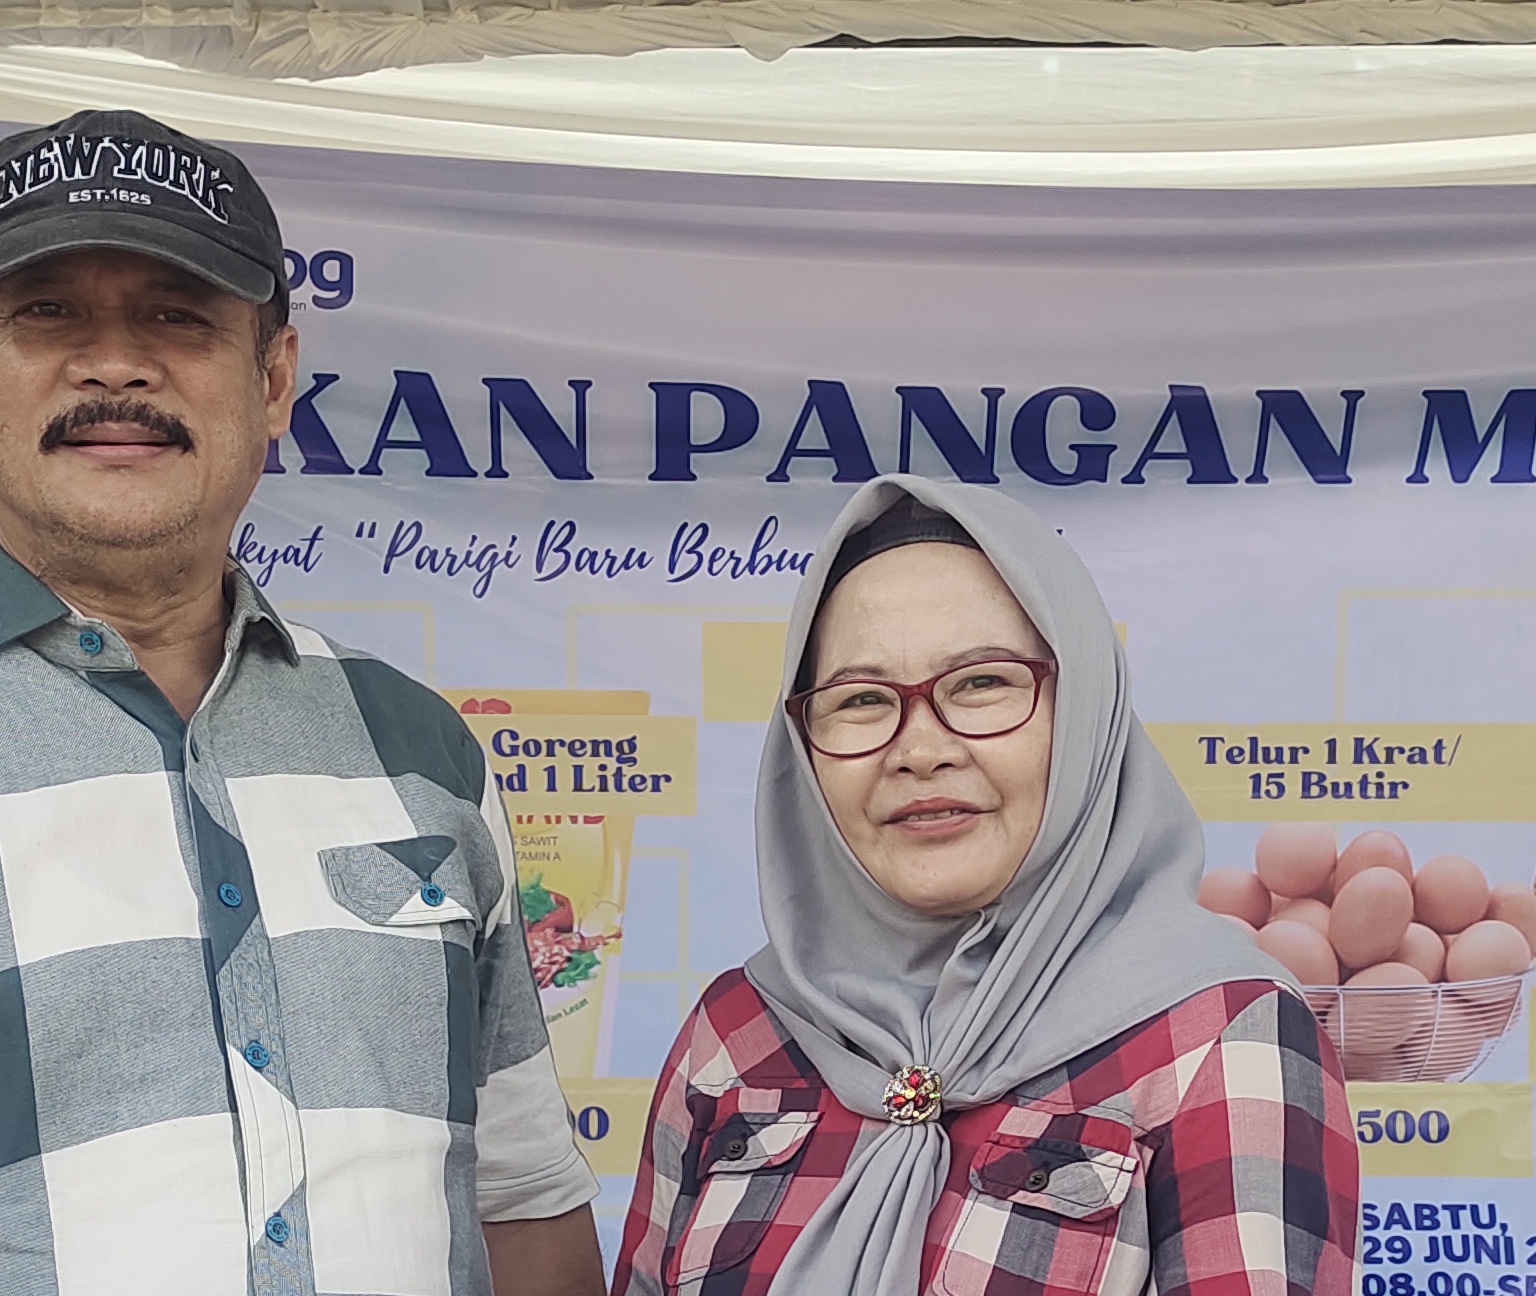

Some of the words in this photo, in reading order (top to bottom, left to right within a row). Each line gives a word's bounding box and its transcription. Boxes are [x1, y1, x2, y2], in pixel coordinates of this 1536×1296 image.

[103, 137, 235, 224] YORK
[647, 378, 1367, 487] PANGAN
[532, 519, 654, 583] Baru
[491, 728, 638, 767] Goreng
[1198, 734, 1311, 768] Telur
[1324, 736, 1339, 767] 1
[1352, 731, 1463, 769] Krat/
[541, 764, 558, 793] 1
[571, 763, 673, 793] Liter
[1247, 770, 1287, 801] 15
[1299, 769, 1411, 802] Butir
[520, 835, 559, 847] SAWIT
[1361, 1202, 1509, 1236] SABTU,
[1362, 1235, 1413, 1265] 29
[1423, 1233, 1515, 1266] JUNI
